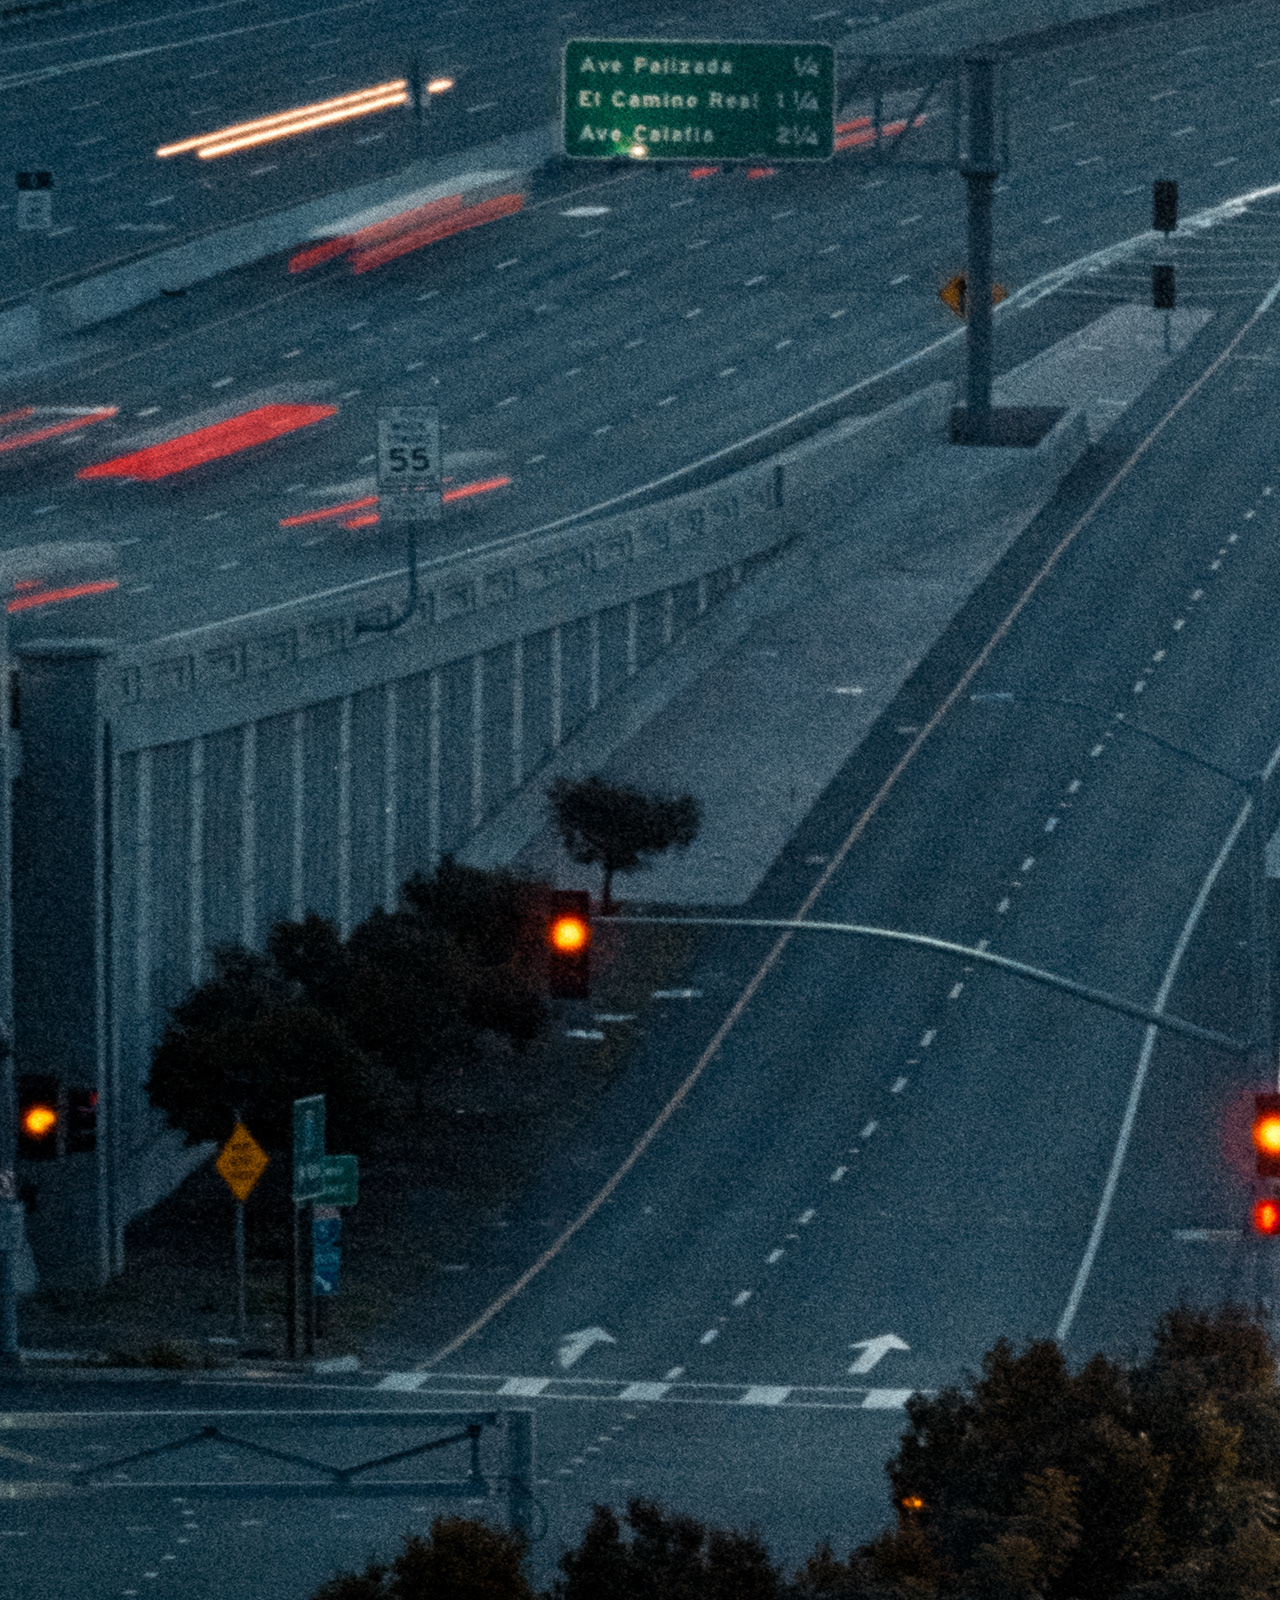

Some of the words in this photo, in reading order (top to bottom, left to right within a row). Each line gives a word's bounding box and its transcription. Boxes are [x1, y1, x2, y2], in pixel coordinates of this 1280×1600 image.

[580, 56, 623, 74] Ave
[633, 56, 733, 75] Palizada
[578, 89, 602, 108] El
[611, 89, 699, 109] Camino
[709, 90, 760, 110] Real
[579, 123, 622, 142] Ave
[633, 123, 714, 143] Calafia
[388, 447, 431, 472] 55
